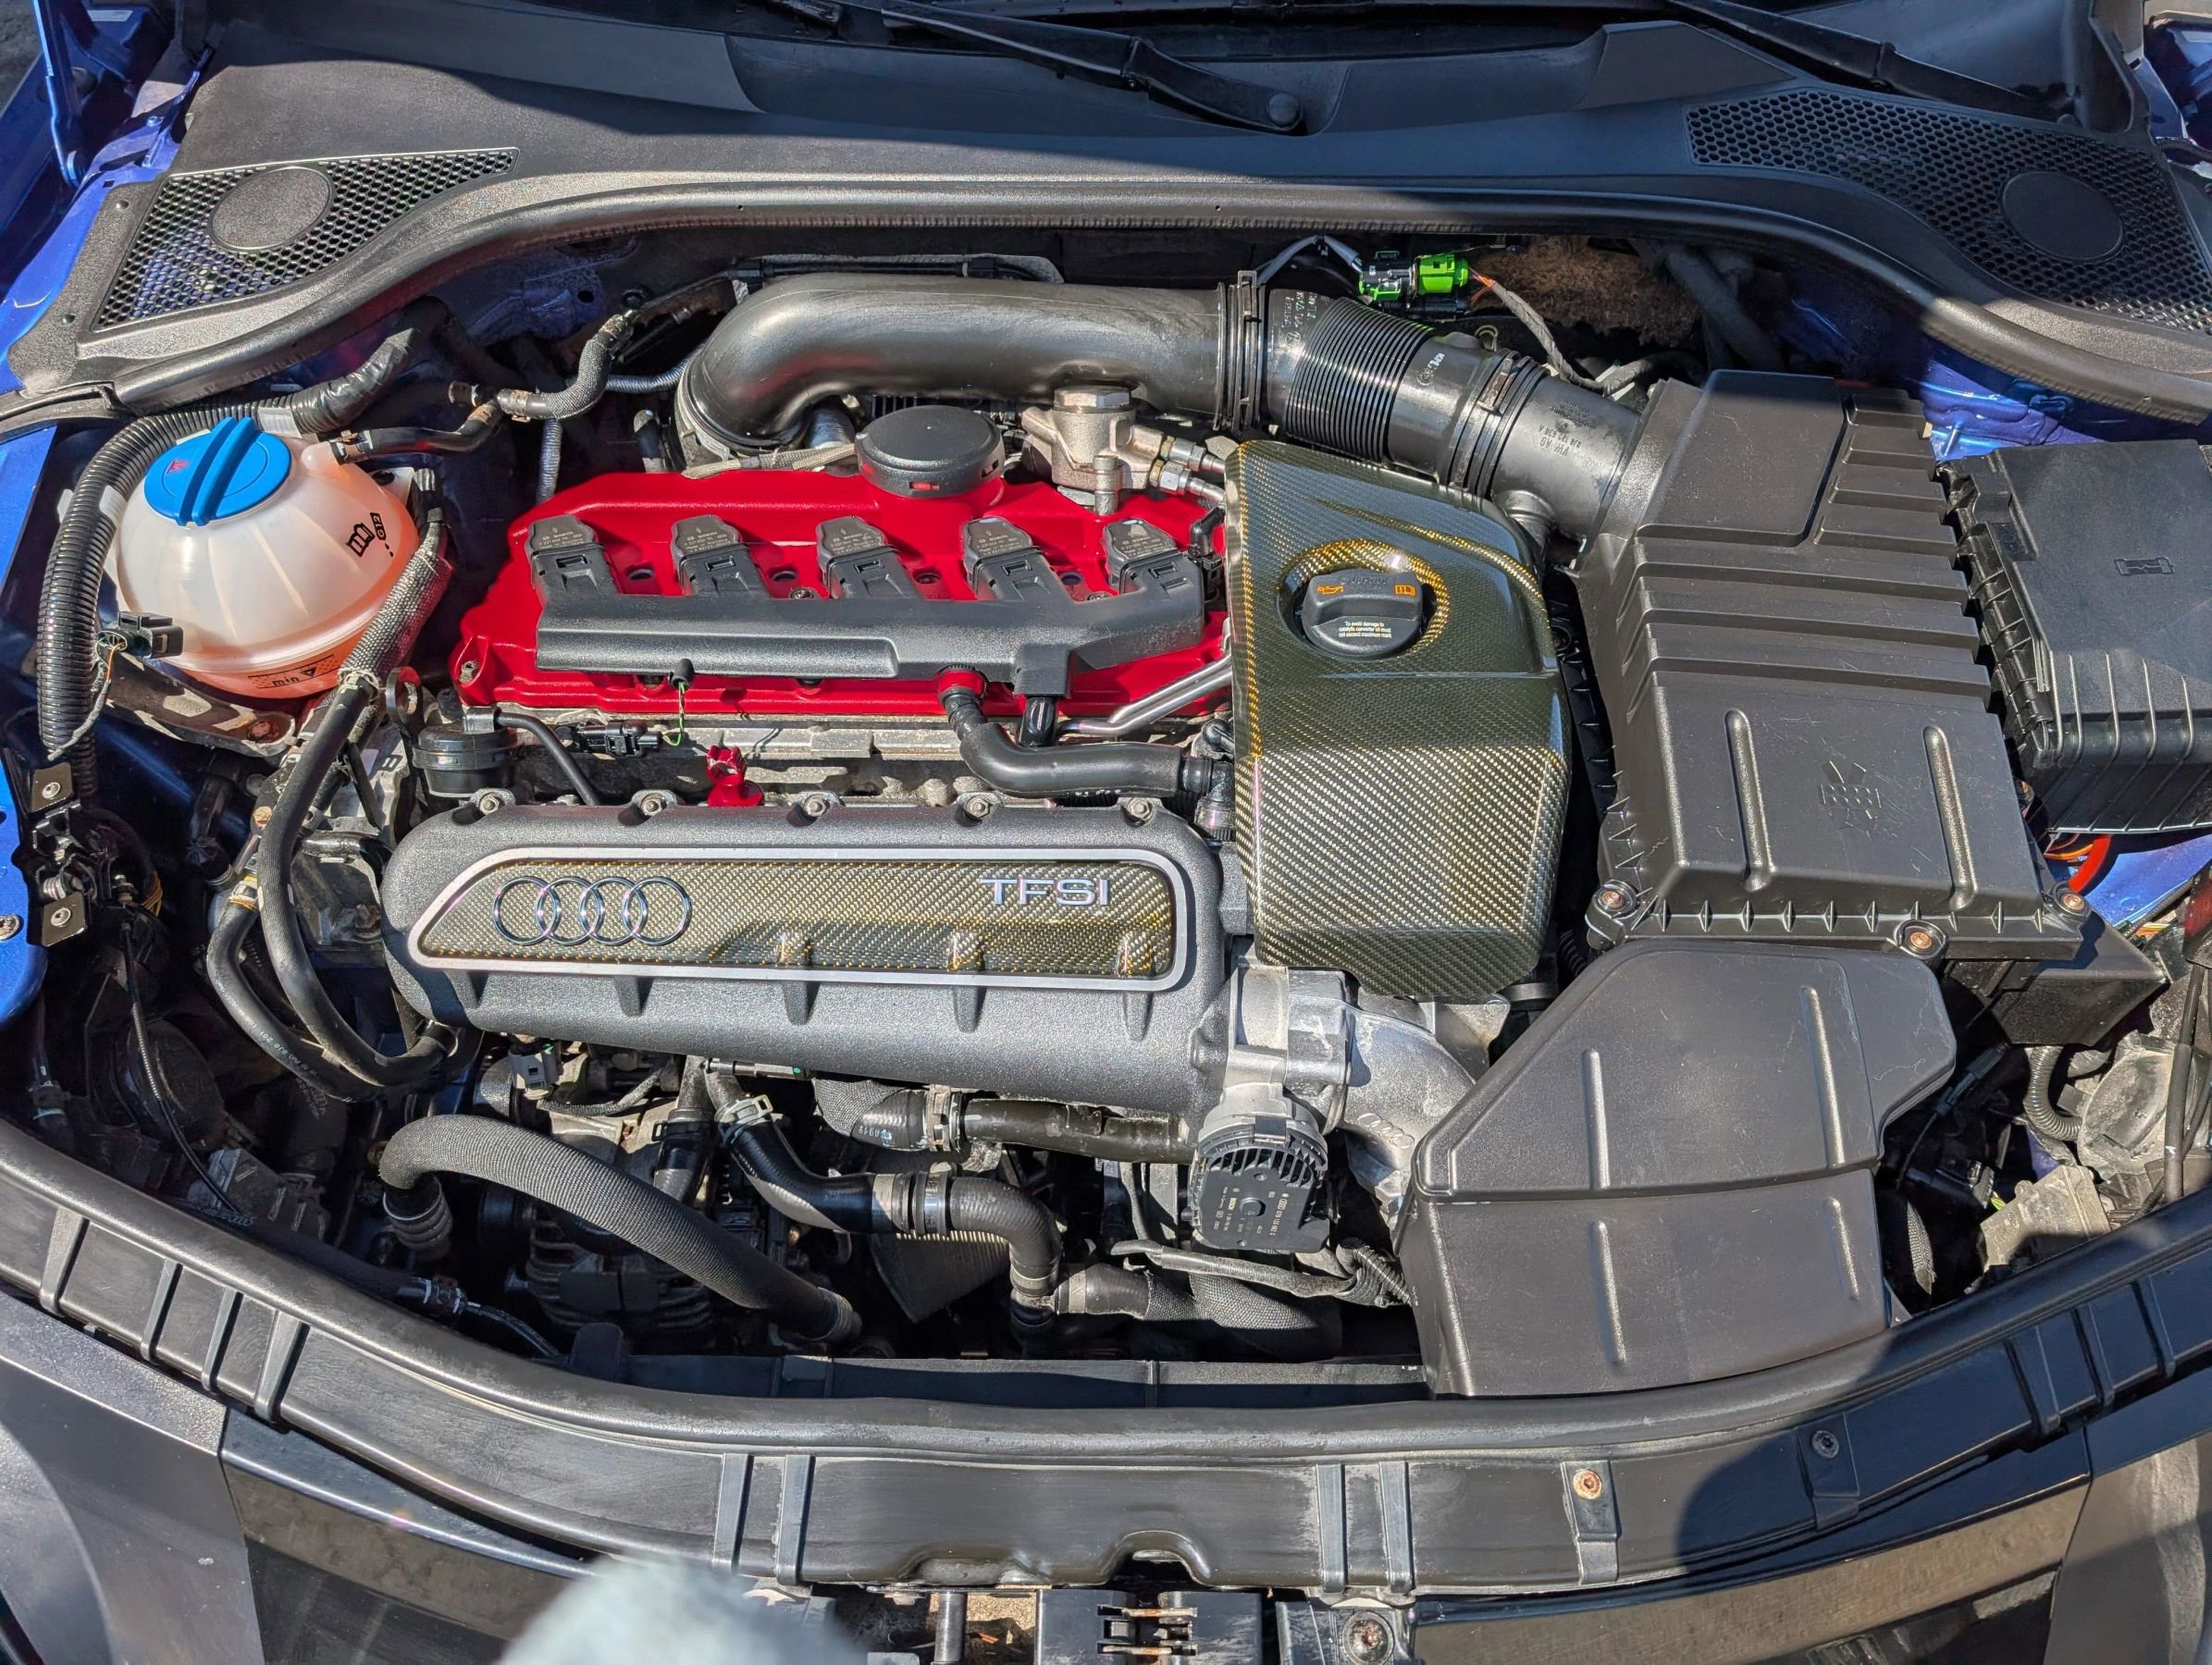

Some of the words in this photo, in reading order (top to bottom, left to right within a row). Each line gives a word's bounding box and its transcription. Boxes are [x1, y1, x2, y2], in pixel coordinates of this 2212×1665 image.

[372, 515, 385, 538] G12
[273, 676, 299, 686] min
[980, 878, 1108, 906] TFSI
